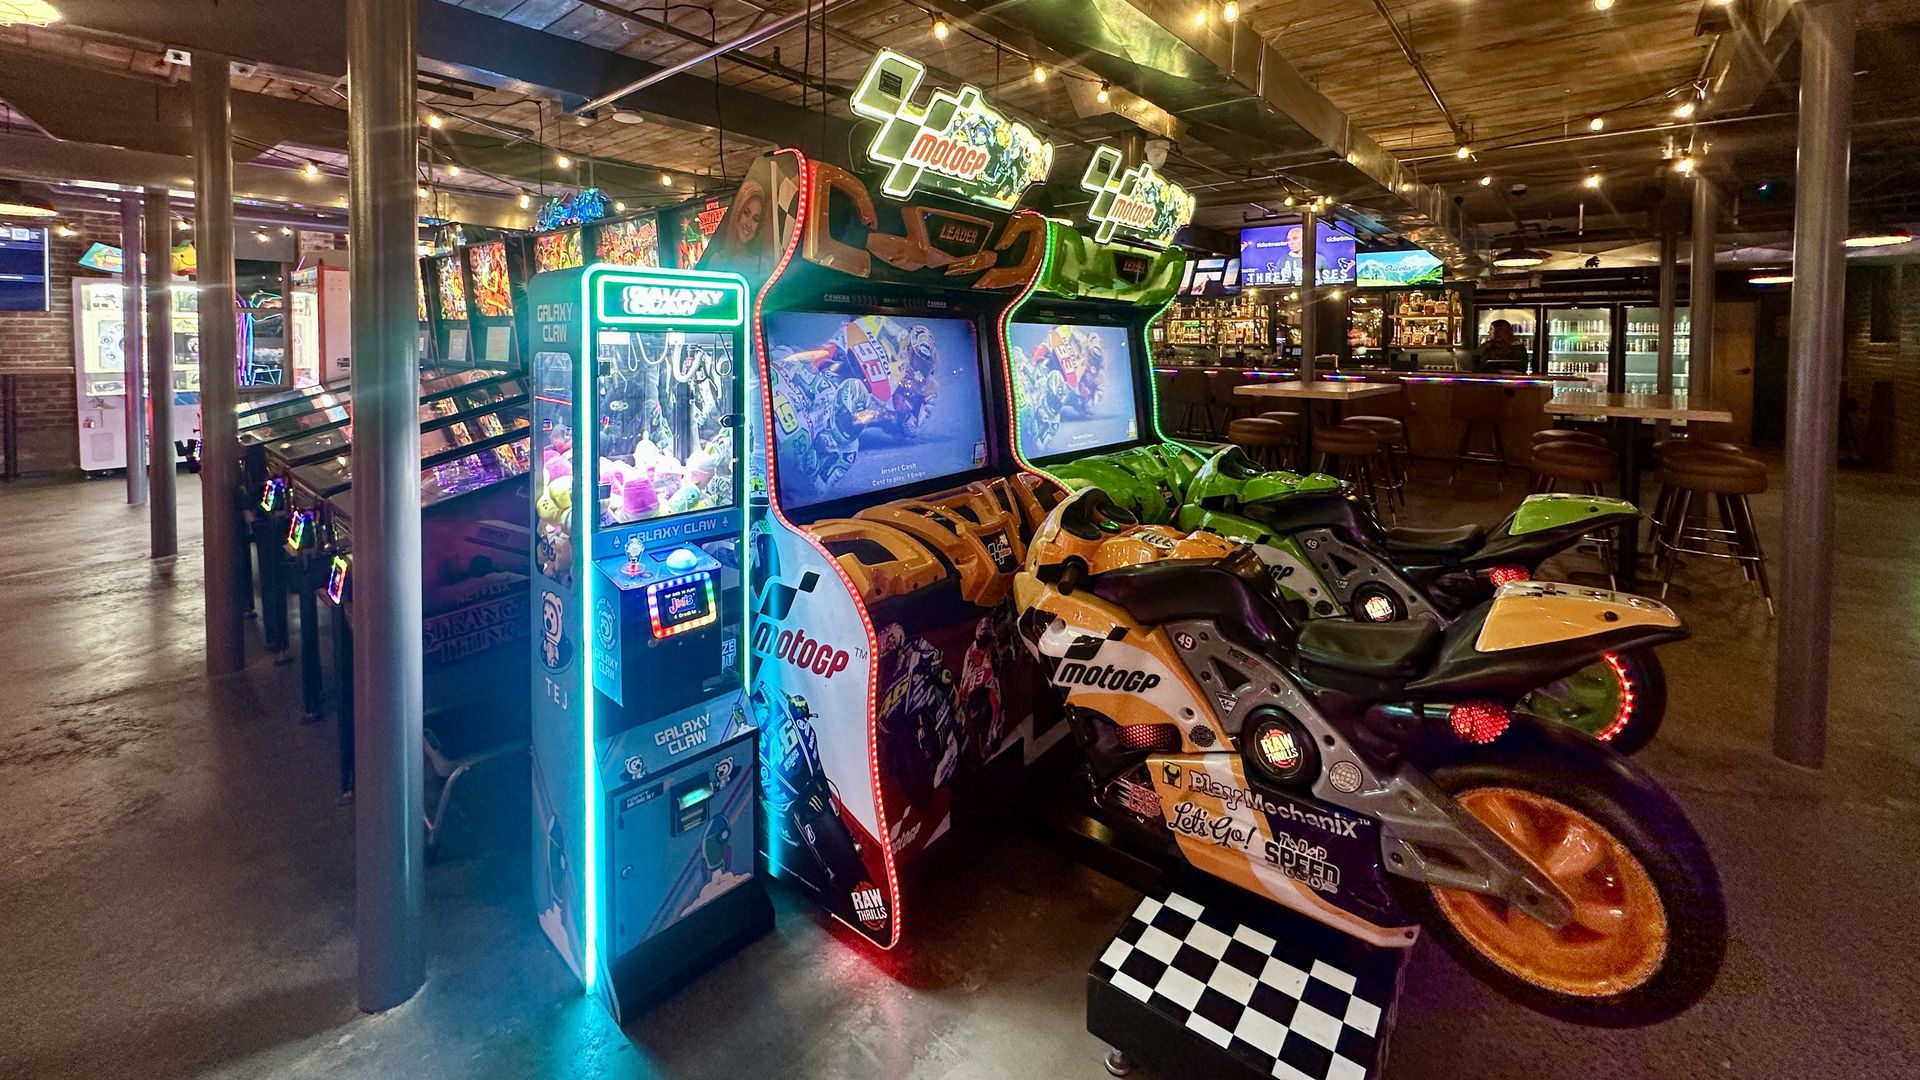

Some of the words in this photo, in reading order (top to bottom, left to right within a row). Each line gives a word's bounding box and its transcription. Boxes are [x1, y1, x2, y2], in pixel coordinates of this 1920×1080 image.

[939, 223, 978, 244] LEADER
[536, 302, 574, 323] GALAXY
[542, 324, 568, 342] CLAW
[881, 466, 900, 475] Insert
[901, 463, 917, 471] Cash
[627, 524, 682, 544] GALAXY
[683, 518, 717, 535] CLAW
[1305, 539, 1318, 550] 49
[1178, 633, 1193, 649] 49
[545, 677, 568, 710] TEJ
[655, 712, 712, 746] GALAXY
[668, 734, 708, 756] CLAW
[1260, 733, 1295, 754] RAW
[1266, 747, 1299, 763] THRILLS
[1168, 802, 1209, 837] Let's
[1209, 816, 1257, 849] Go!
[1264, 841, 1340, 886] SPEED
[851, 888, 883, 910] RAW
[856, 906, 888, 922] THRILLS
